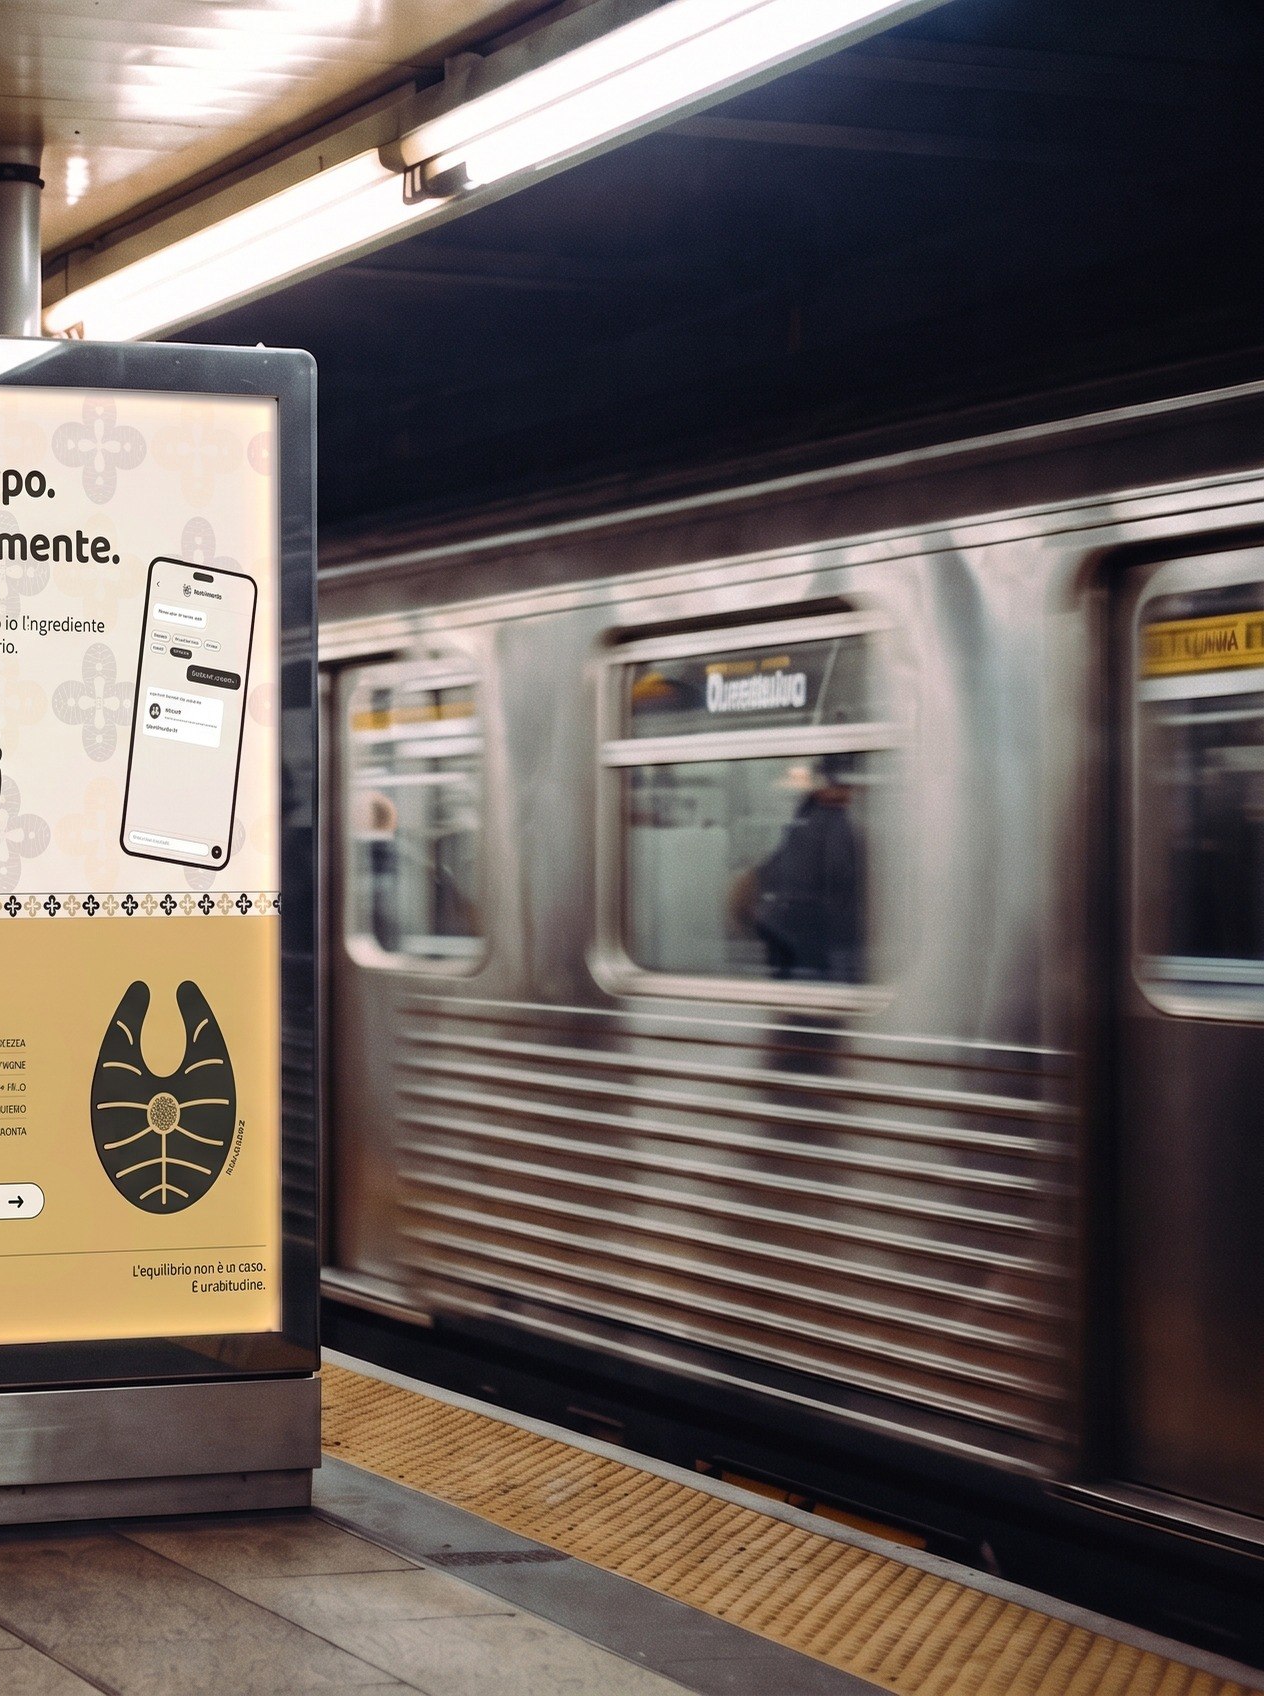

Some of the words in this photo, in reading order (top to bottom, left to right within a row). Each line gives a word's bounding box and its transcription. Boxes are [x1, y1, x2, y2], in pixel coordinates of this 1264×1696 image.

[5, 615, 18, 631] io
[132, 1262, 192, 1281] L'equilibrio
[193, 1264, 215, 1275] non
[216, 1261, 224, 1274] è
[238, 1262, 267, 1273] caso.
